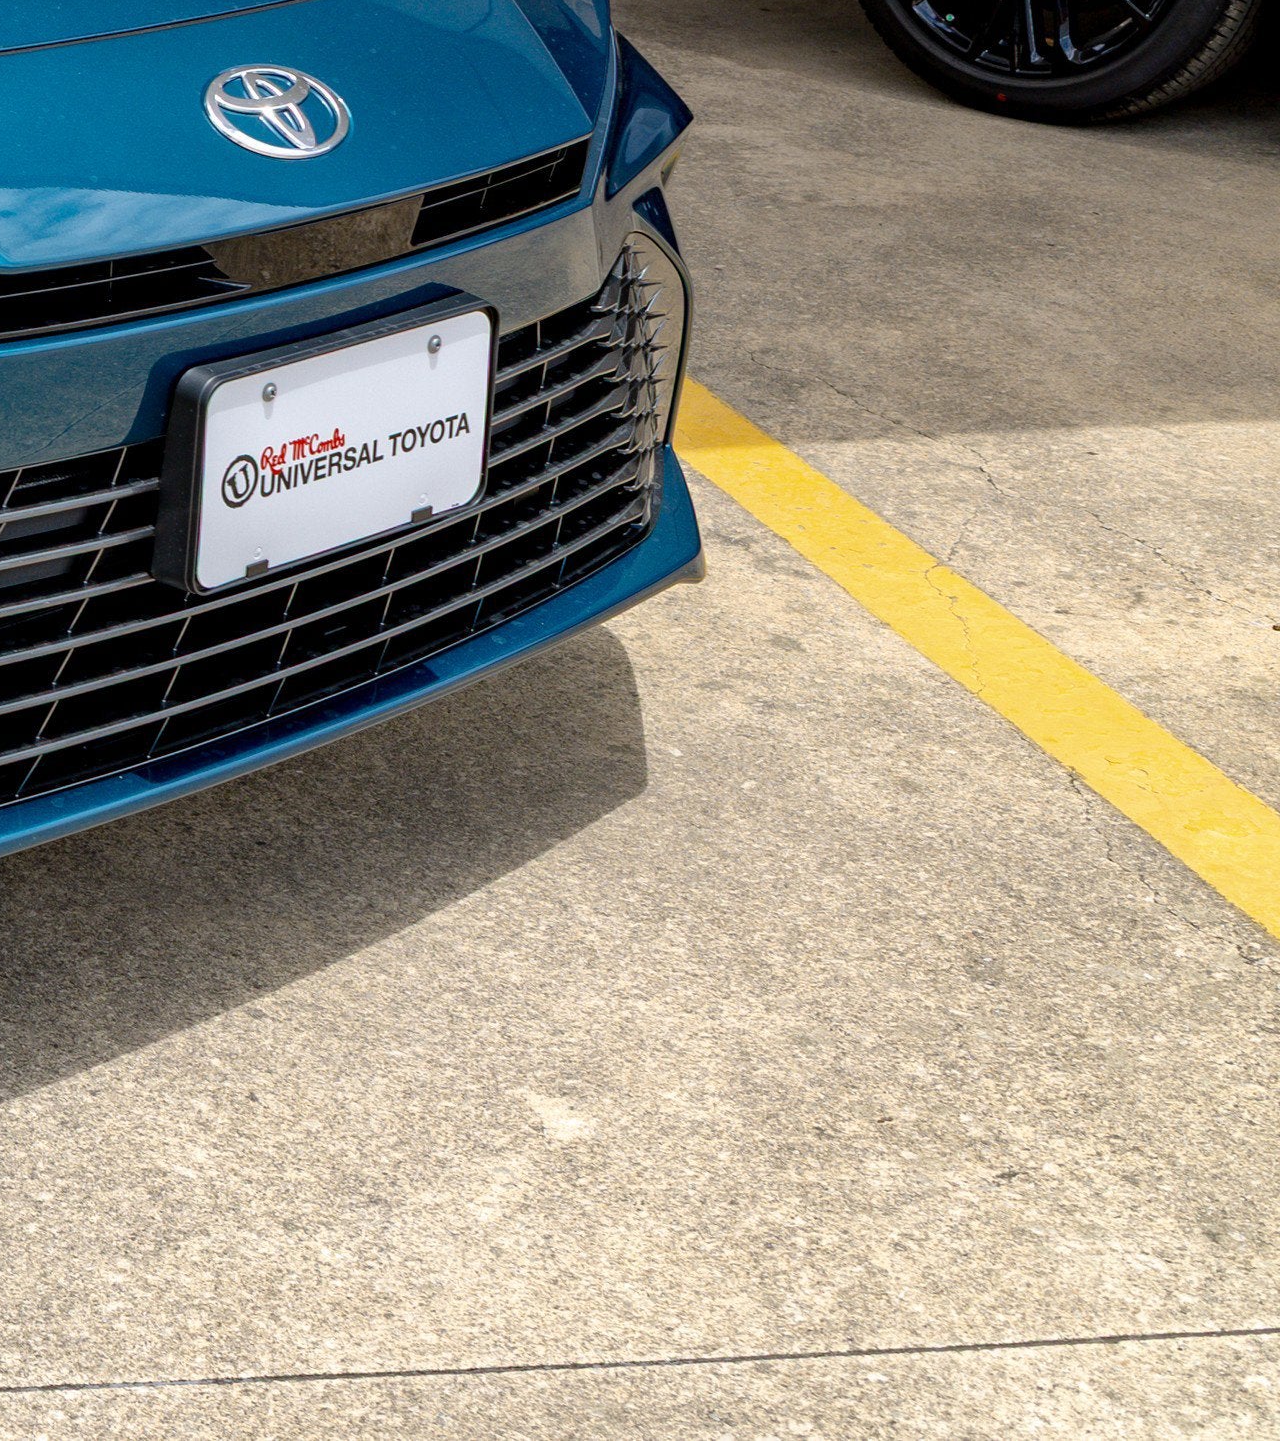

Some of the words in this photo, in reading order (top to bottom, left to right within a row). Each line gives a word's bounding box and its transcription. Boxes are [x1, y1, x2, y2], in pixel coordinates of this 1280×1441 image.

[260, 443, 287, 475] Red
[289, 428, 345, 460] McCombs
[260, 439, 384, 497] UNIVERSAL
[388, 412, 470, 456] TOYOTA
